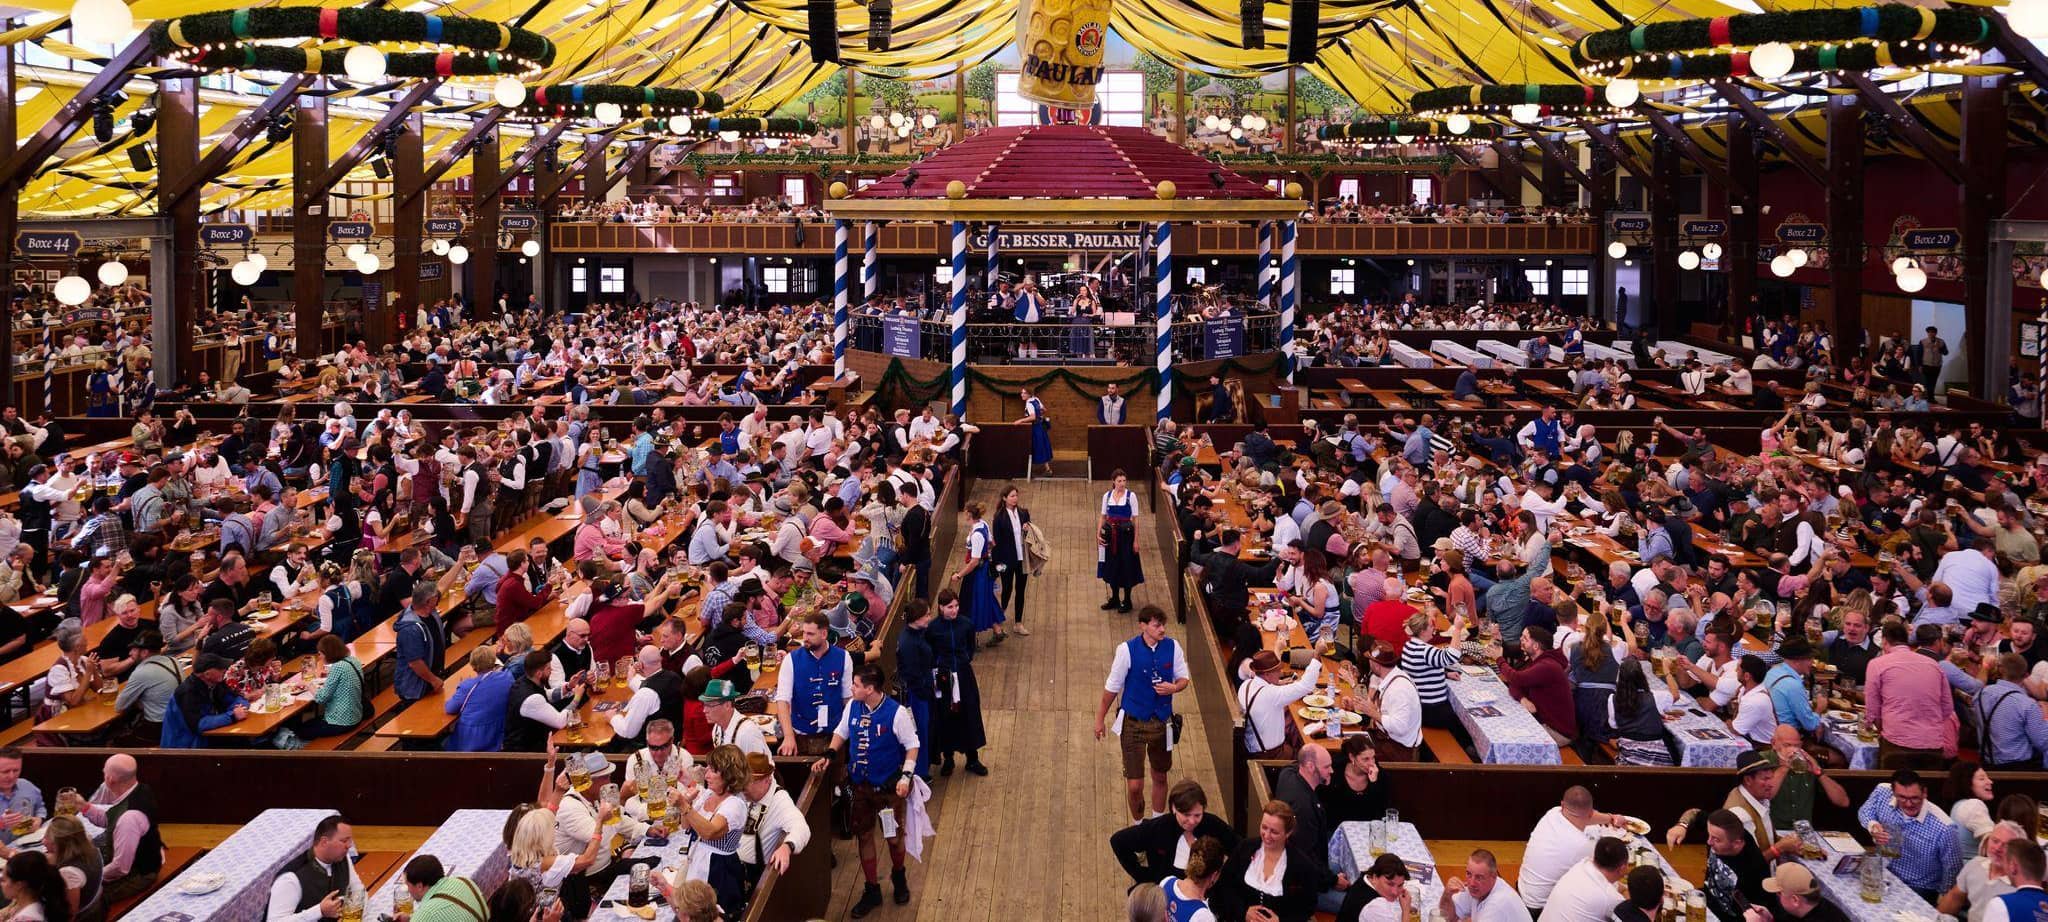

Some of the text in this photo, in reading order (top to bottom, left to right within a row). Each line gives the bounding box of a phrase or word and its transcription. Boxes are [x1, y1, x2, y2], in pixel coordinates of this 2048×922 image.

[337, 226, 365, 236] Boxe 31
[432, 222, 457, 231] Boxe 32
[210, 229, 244, 241] Boxe 30
[1787, 228, 1817, 237] Boxe 21
[976, 234, 1010, 248] GT,
[1013, 234, 1073, 249] BESSER,
[1914, 234, 1951, 244] Boxe 20
[27, 238, 53, 249] Boxe
[53, 238, 70, 251] 44
